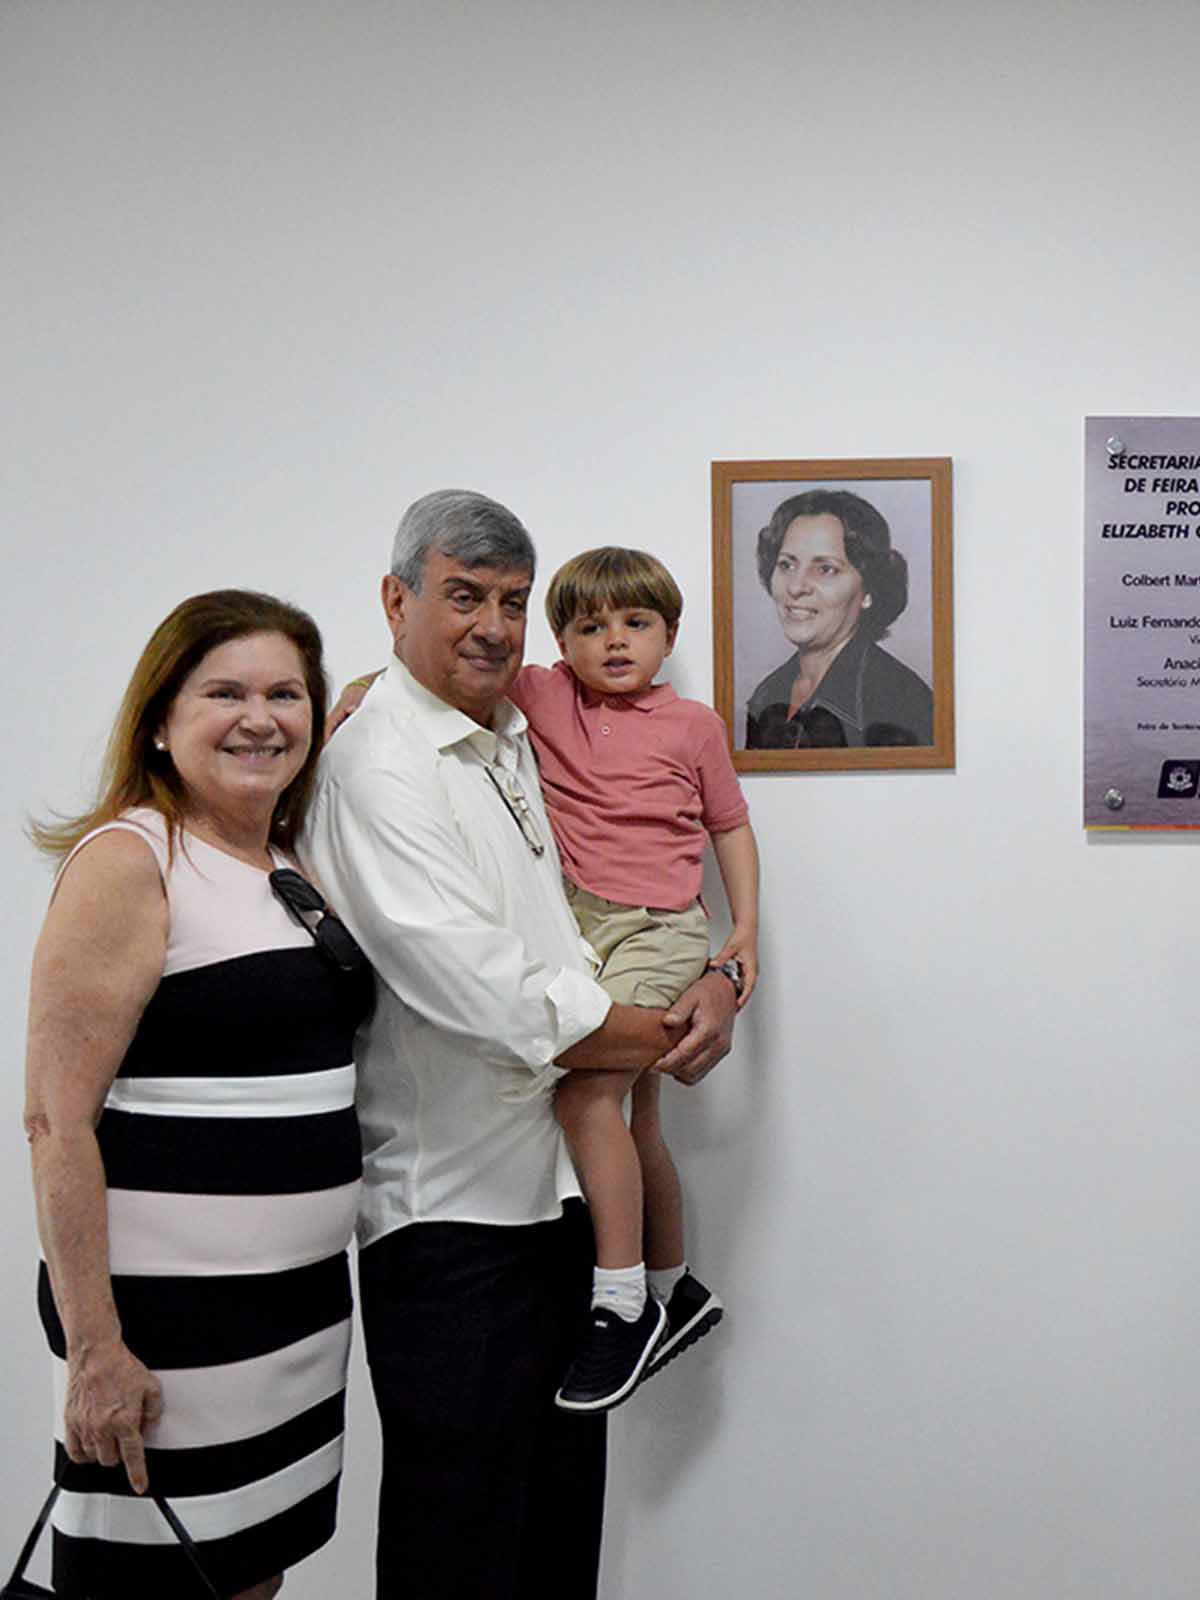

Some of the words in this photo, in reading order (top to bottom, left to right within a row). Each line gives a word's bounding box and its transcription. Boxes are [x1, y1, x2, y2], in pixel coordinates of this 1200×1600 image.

[1124, 478, 1147, 494] DE
[1152, 478, 1199, 494] FEIRA
[1102, 524, 1190, 540] ELIZABETH
[1122, 574, 1171, 588] Colbert
[1110, 616, 1138, 629] Luiz
[1164, 657, 1200, 671] Anaci
